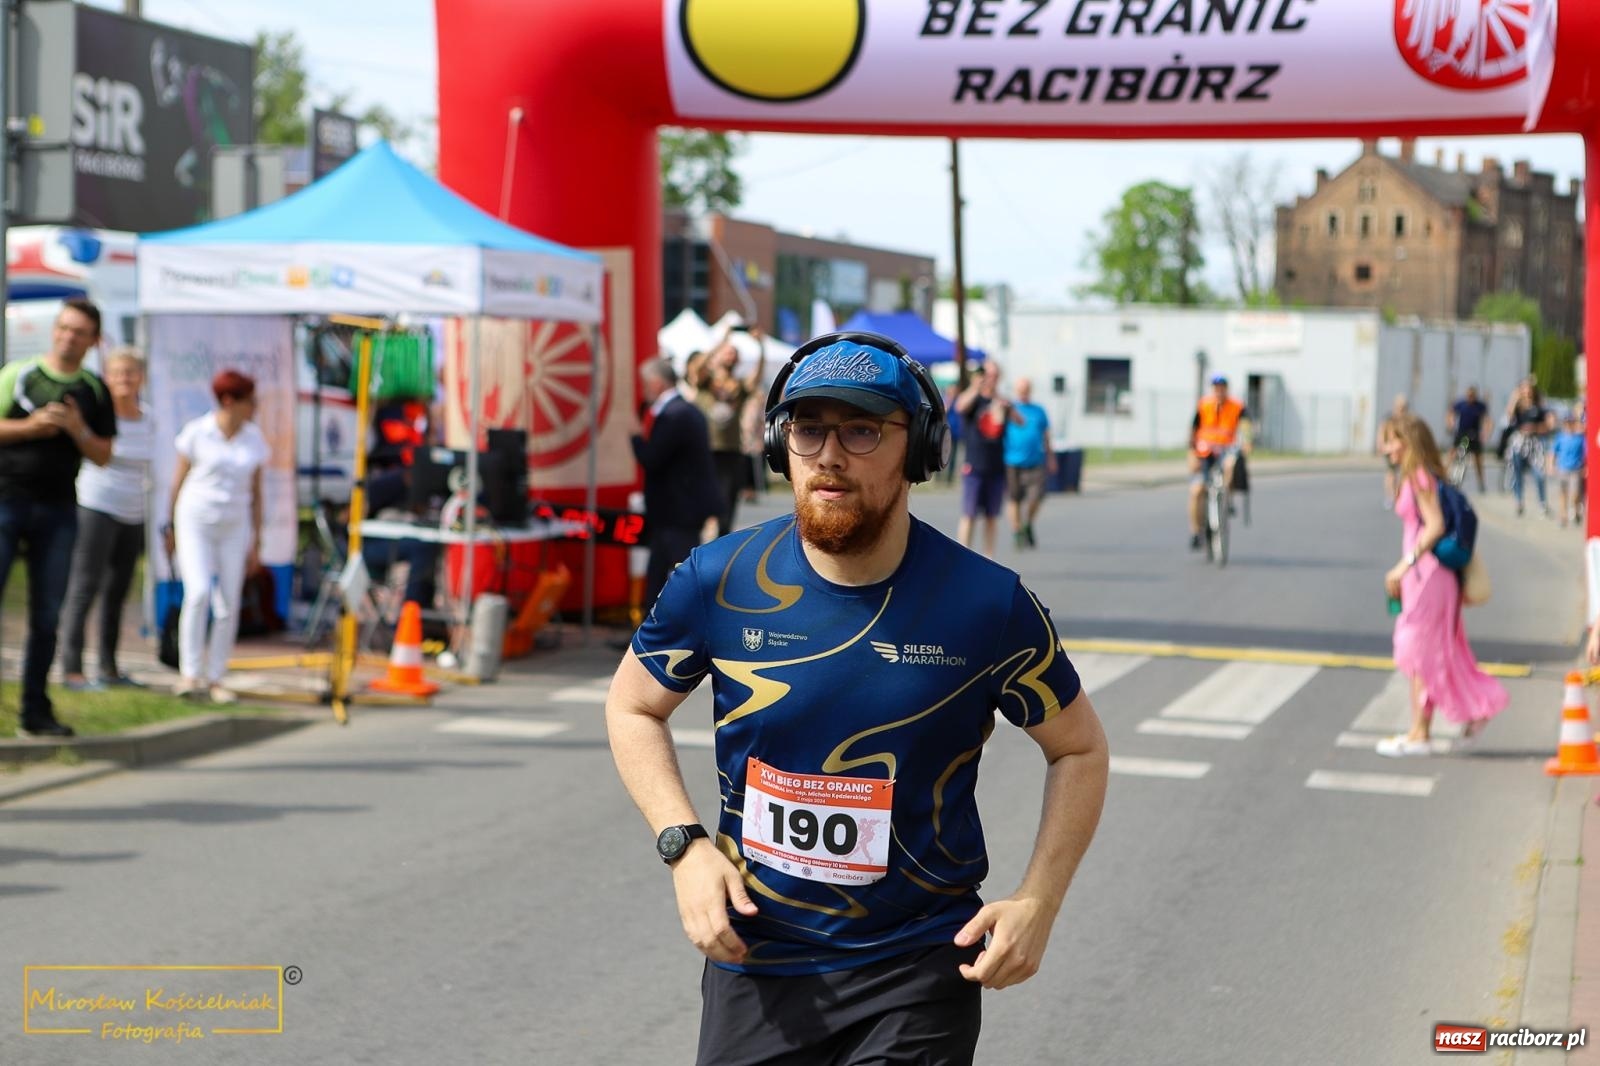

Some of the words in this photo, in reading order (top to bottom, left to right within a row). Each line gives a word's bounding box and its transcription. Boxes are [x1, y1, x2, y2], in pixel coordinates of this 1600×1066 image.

[919, 0, 1050, 36] BEZ
[1064, 0, 1313, 35] GRANIC
[952, 53, 1283, 103] RACIBÓRZ
[768, 631, 808, 641] Województwo
[903, 644, 944, 655] SILESIA
[902, 654, 967, 666] MARATHON
[760, 768, 776, 782] XVI
[777, 776, 801, 788] BIEG
[803, 780, 825, 790] BEZ
[826, 781, 874, 794] GRANIC
[831, 793, 872, 802] Kędzierskiego
[768, 802, 858, 856] 190
[832, 872, 864, 881] Racibórz
